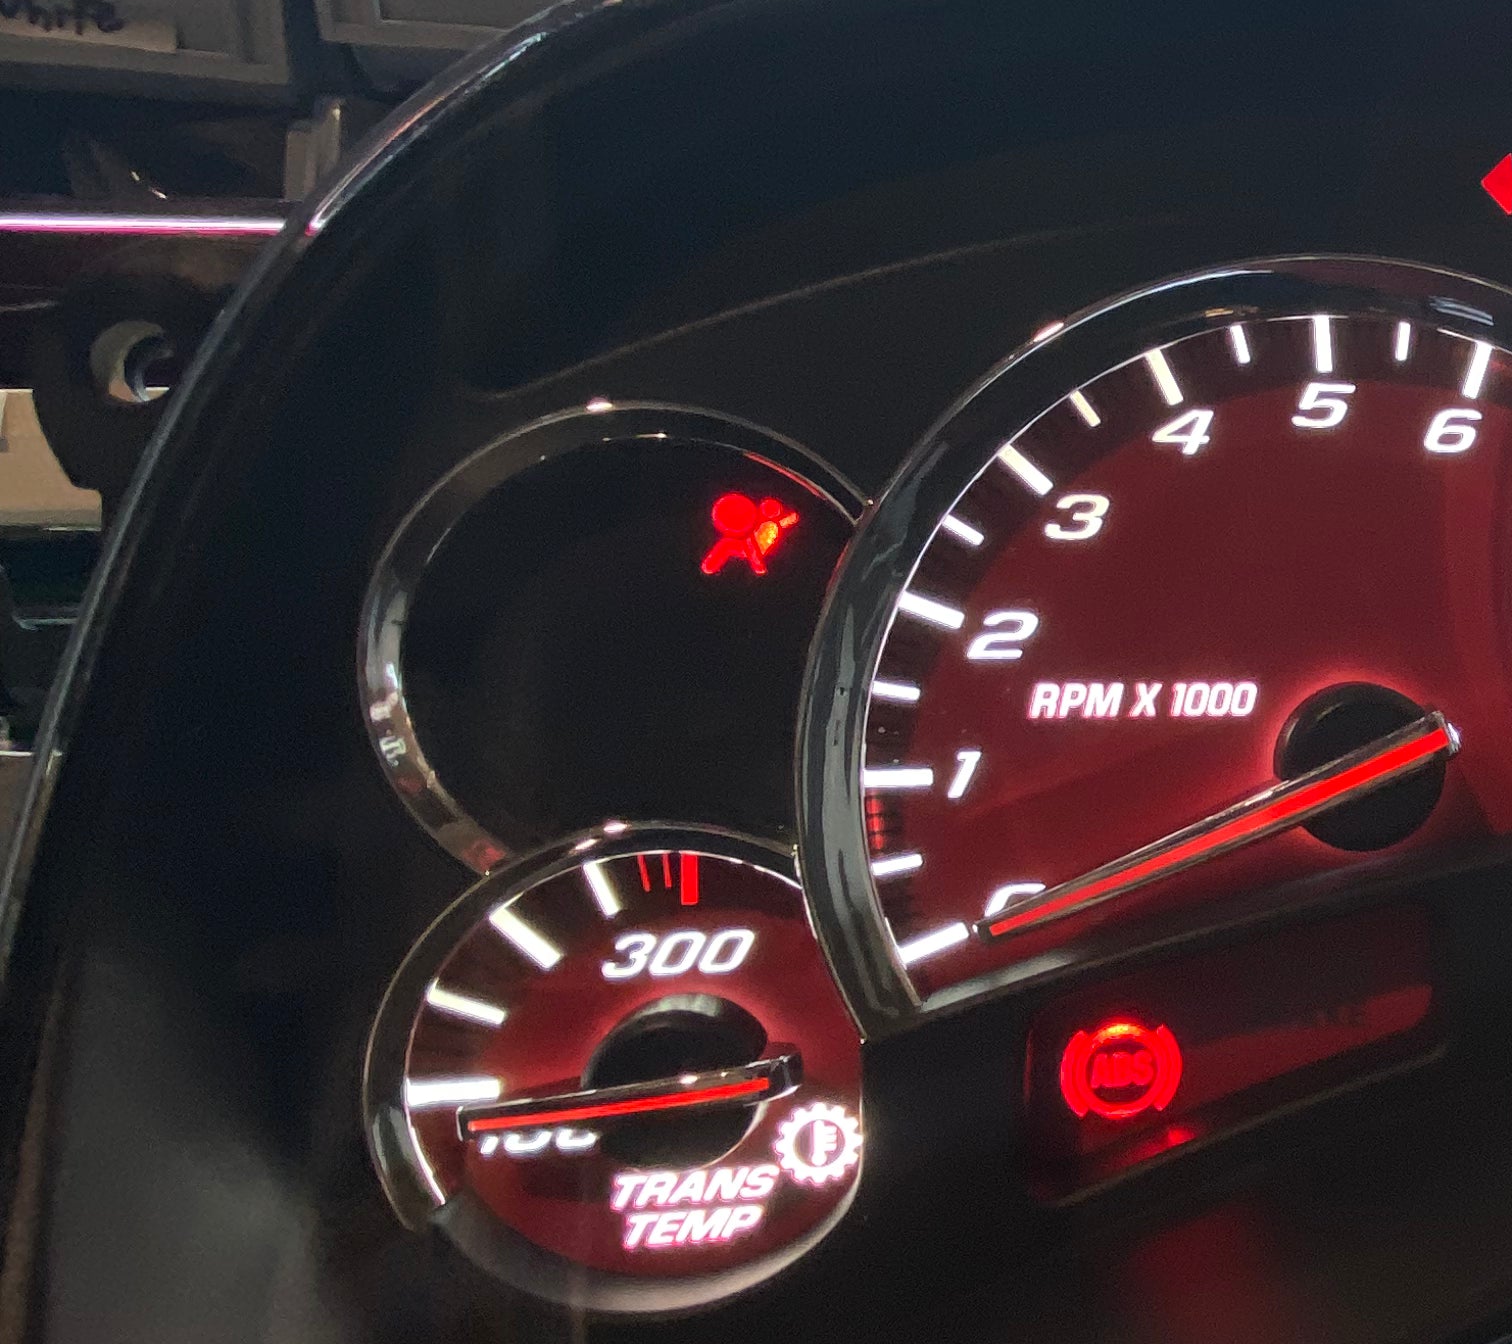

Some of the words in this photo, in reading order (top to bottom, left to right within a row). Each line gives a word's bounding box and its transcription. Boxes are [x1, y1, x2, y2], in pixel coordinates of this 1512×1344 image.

[1291, 381, 1357, 429] 5
[1151, 408, 1215, 456] 4
[1423, 409, 1483, 454] 6
[1043, 492, 1110, 541] 3
[966, 609, 1039, 660] 2
[1027, 681, 1124, 719] RPM
[1129, 682, 1162, 718] X
[1170, 681, 1258, 718] 1000
[947, 750, 982, 799] 1
[601, 929, 756, 979] 300
[611, 1163, 781, 1212] TRANS
[625, 1205, 765, 1250] TEMP
